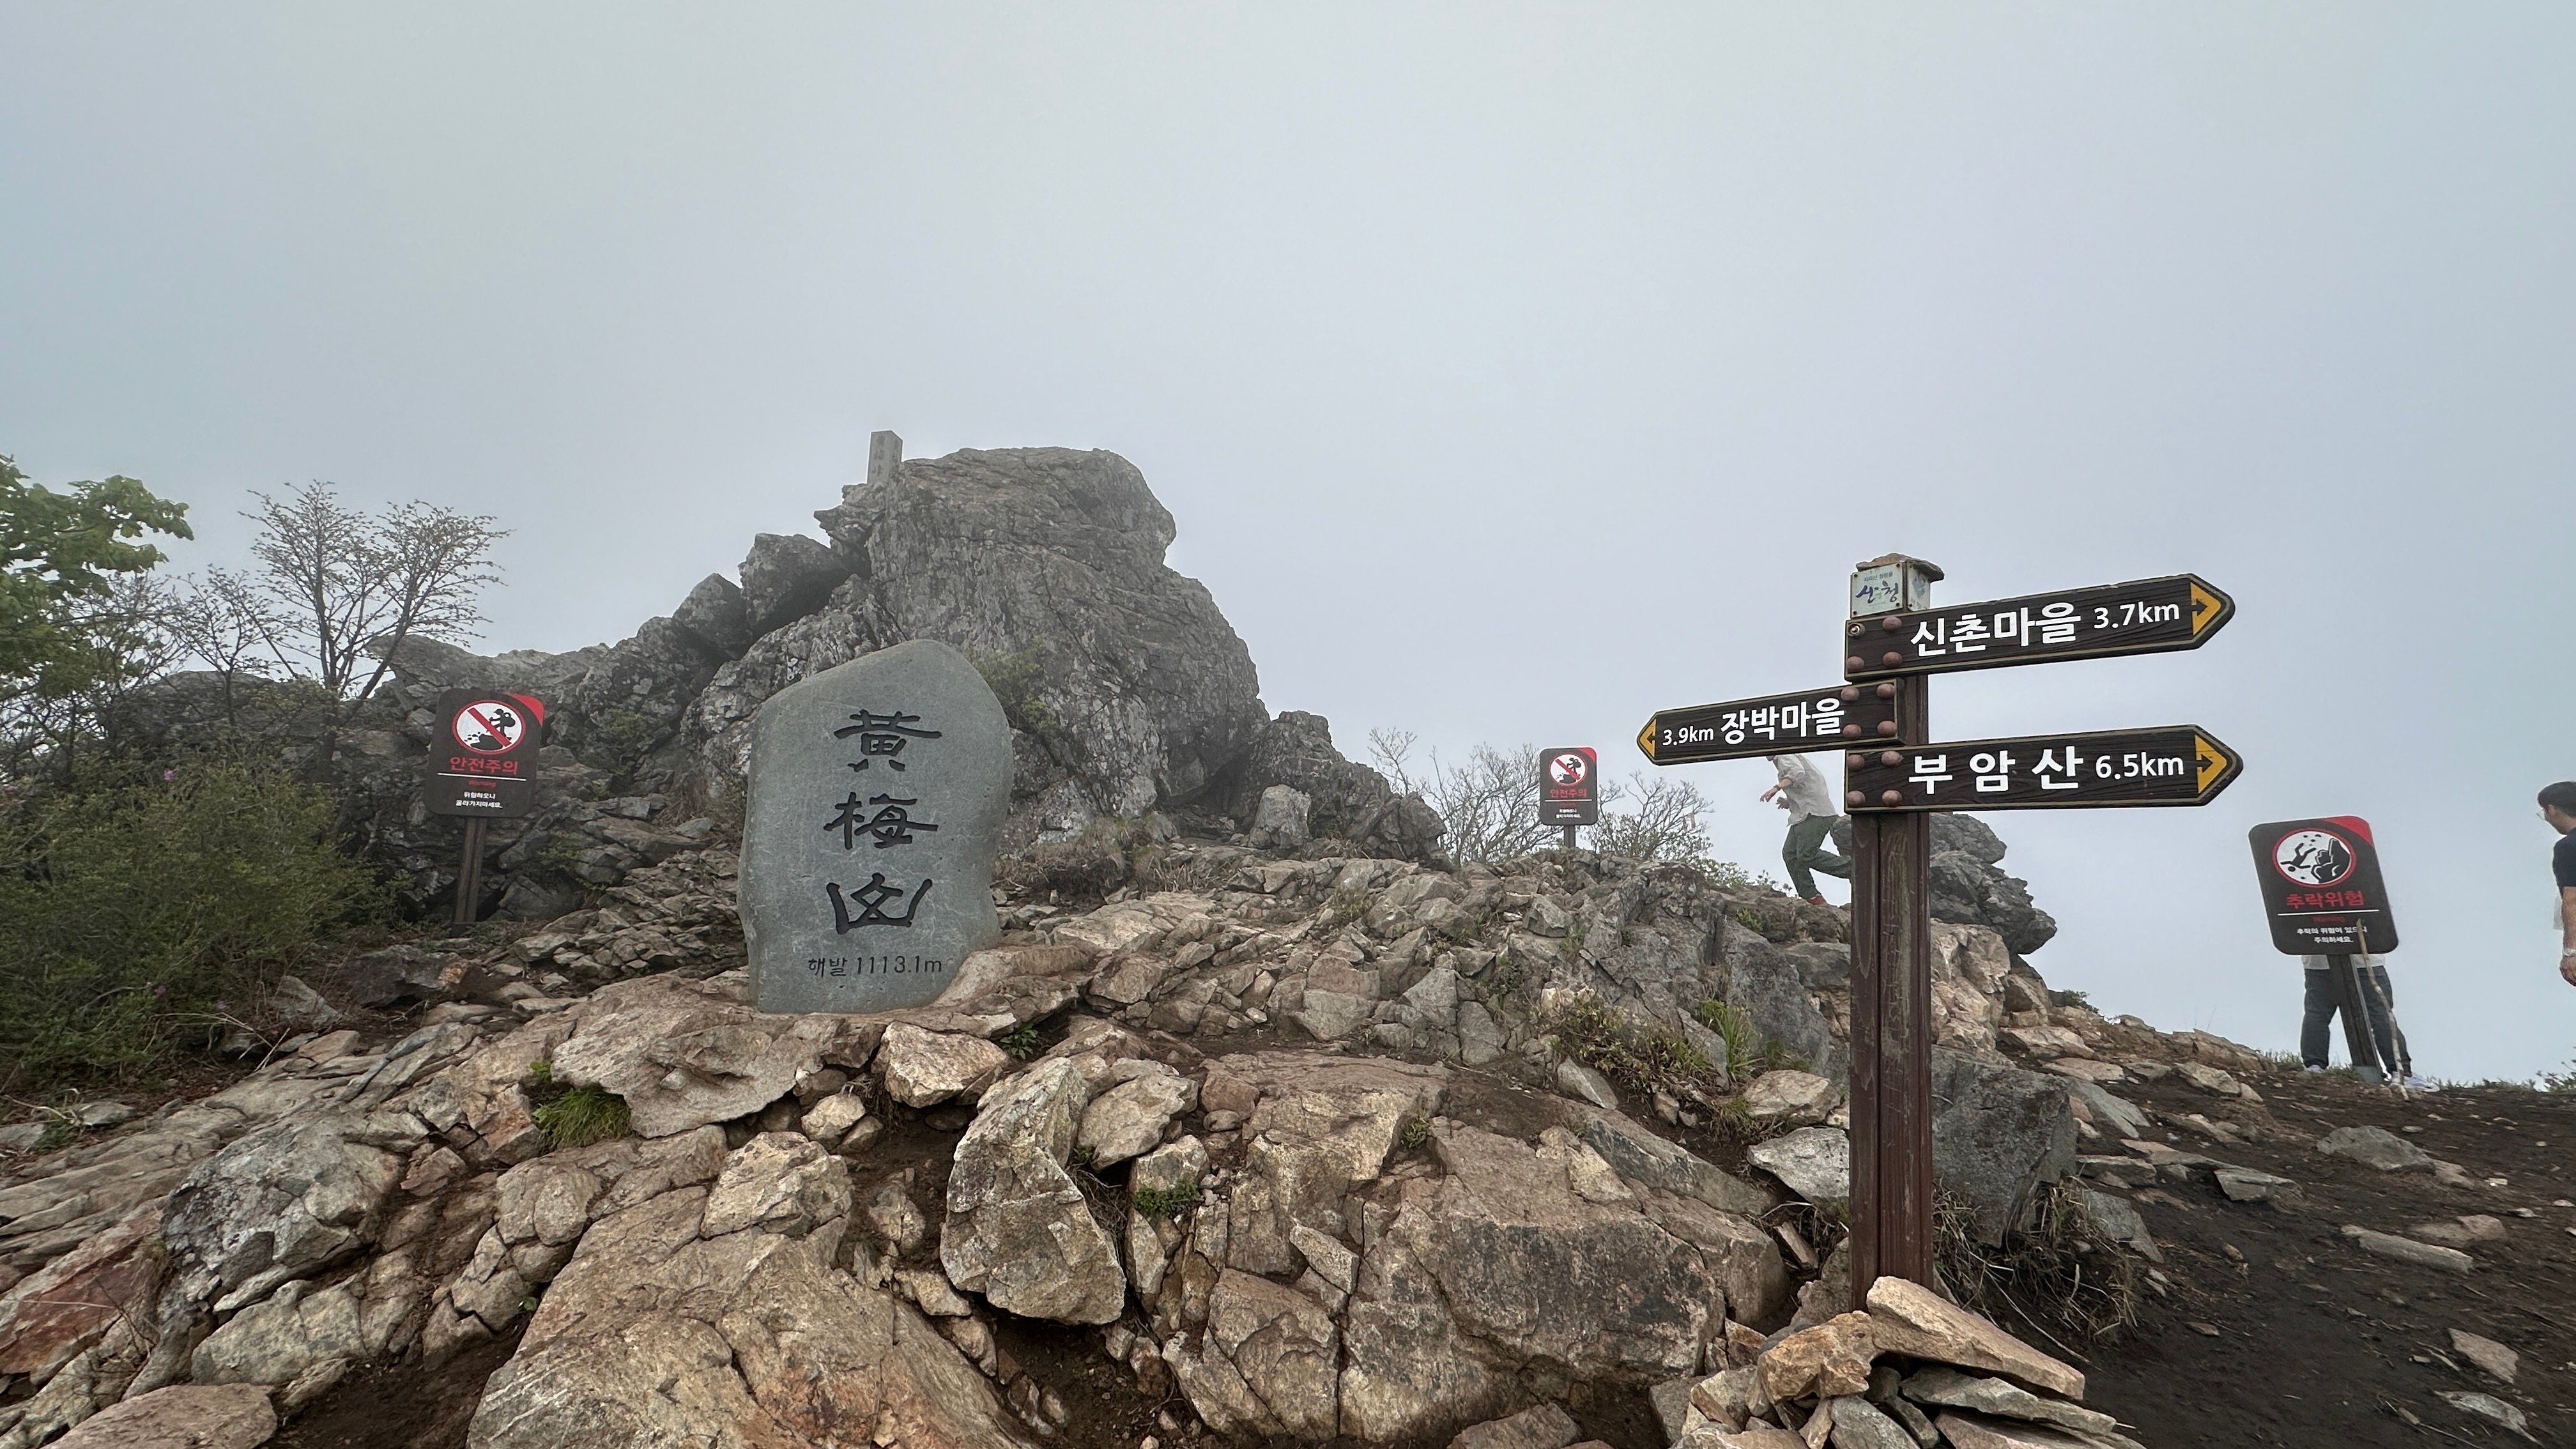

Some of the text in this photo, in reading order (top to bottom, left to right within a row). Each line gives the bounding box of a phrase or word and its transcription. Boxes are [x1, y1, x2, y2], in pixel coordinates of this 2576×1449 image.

[1855, 580, 1899, 604] 산청
[1910, 601, 2181, 657] 신촌마을 3.7km
[1662, 698, 1846, 746] 3.9km 장박마을
[449, 756, 519, 776] 안전주의
[2095, 751, 2184, 780] 6.5km
[1549, 788, 1587, 798] 안전주의
[2286, 890, 2365, 908] 추락위험
[808, 955, 942, 978] 해발 1113.1m
